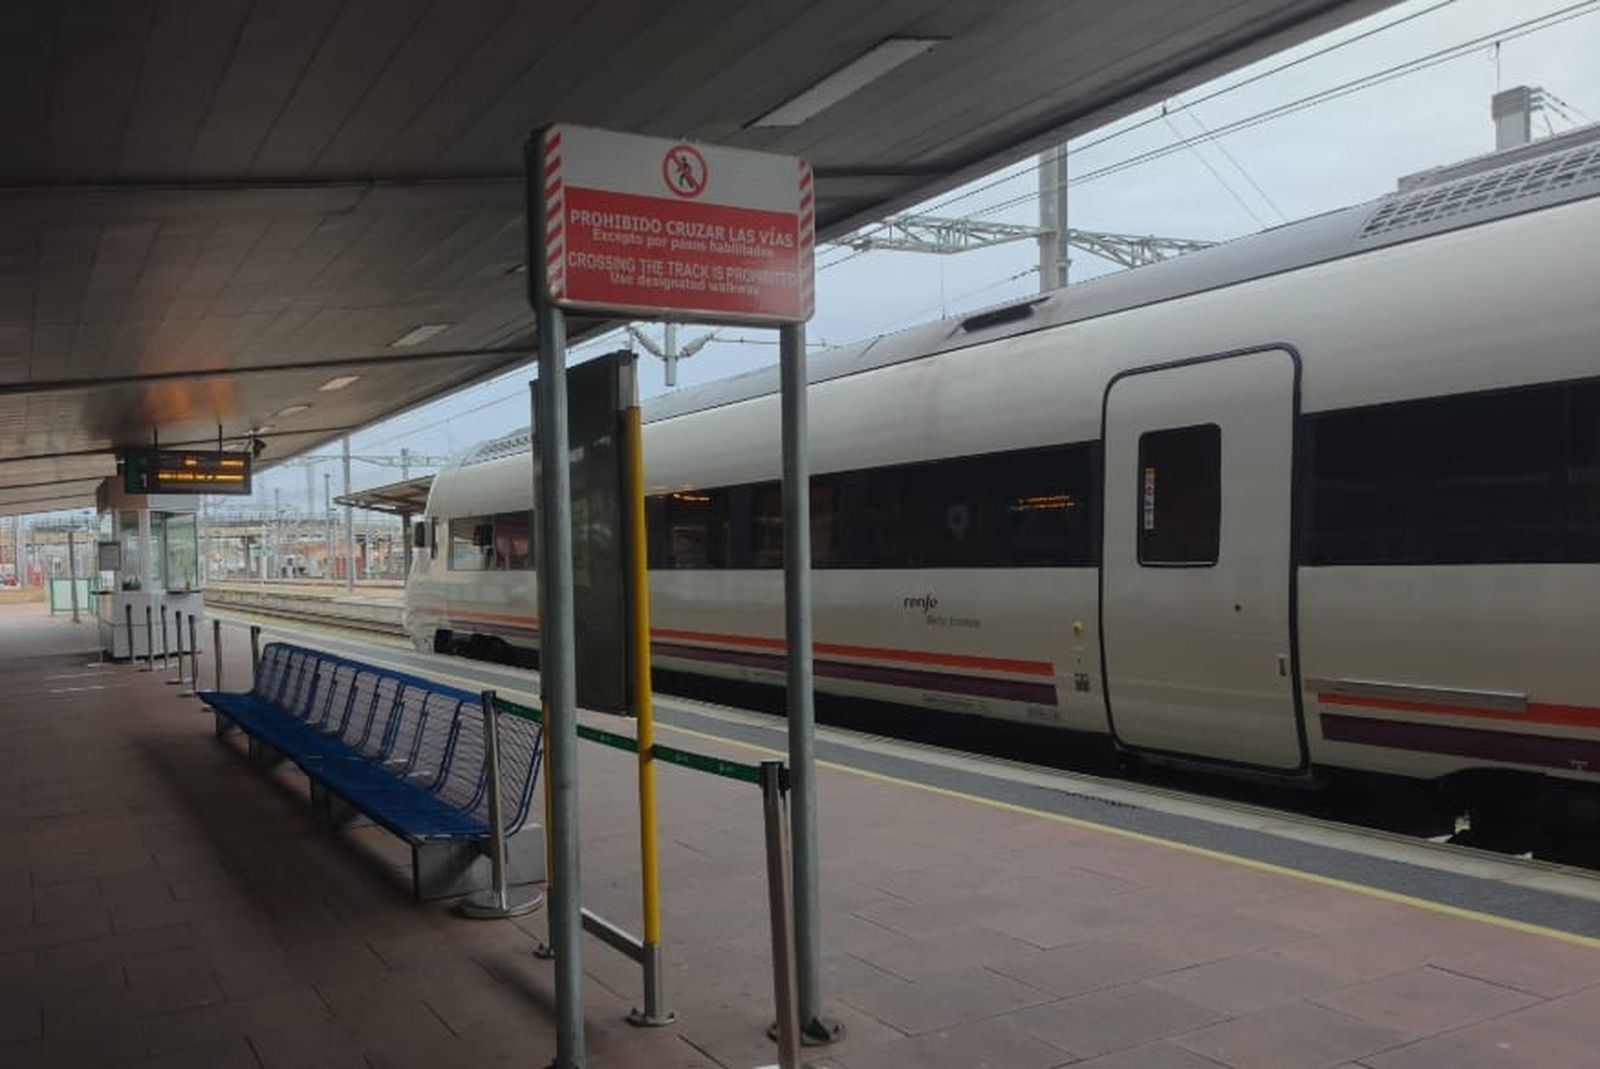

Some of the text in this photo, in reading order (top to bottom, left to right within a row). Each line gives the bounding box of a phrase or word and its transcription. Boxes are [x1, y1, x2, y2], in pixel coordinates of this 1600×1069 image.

[570, 209, 794, 248] PROHIBIDO CRUZAR LAS VÍAS
[592, 228, 643, 246] Excepto
[647, 235, 667, 249] por
[568, 251, 796, 287] CROSSING THE TRACK IS PROTED
[611, 271, 635, 285] Use
[904, 594, 938, 614] renfe
